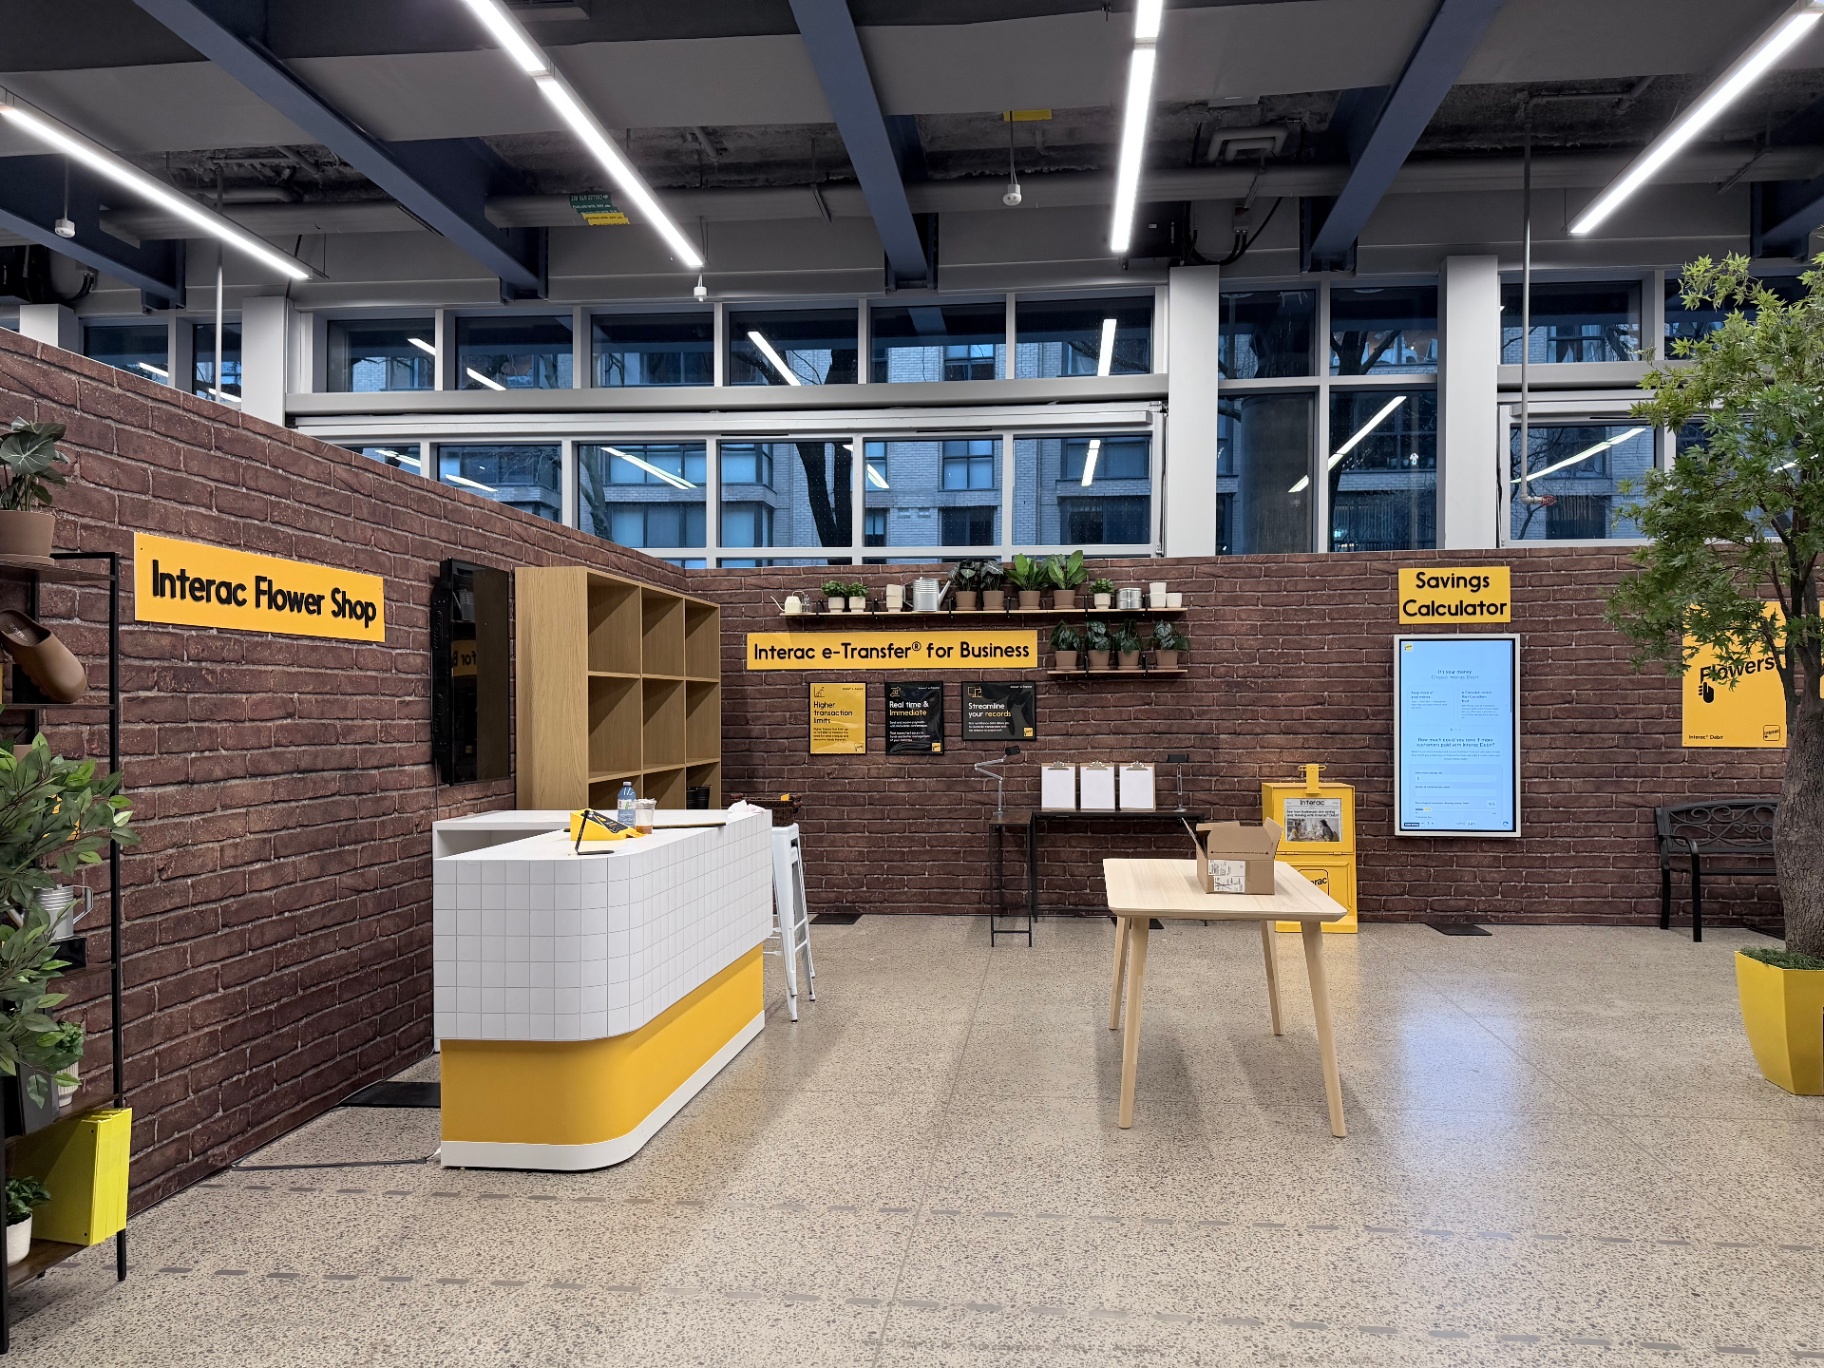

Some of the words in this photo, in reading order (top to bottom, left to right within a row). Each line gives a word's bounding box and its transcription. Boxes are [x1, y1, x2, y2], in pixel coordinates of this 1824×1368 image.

[1416, 571, 1490, 593] Savings
[152, 559, 248, 607] Interac
[254, 575, 325, 616] Flower
[331, 587, 377, 629] Shop
[1403, 599, 1507, 617] Calculator
[754, 643, 816, 660] Interac
[822, 641, 922, 660] e-Transfer®
[927, 642, 954, 659] for
[960, 641, 1030, 659] Business
[1700, 657, 1775, 684] Flowers
[813, 700, 836, 710] Higher
[889, 700, 905, 709] Real
[905, 701, 922, 709] time
[922, 700, 929, 708] &
[968, 702, 1005, 710] Streamline
[813, 709, 853, 717] transaction
[889, 709, 927, 717] Immediate
[968, 711, 984, 719] your
[984, 710, 1012, 718] records
